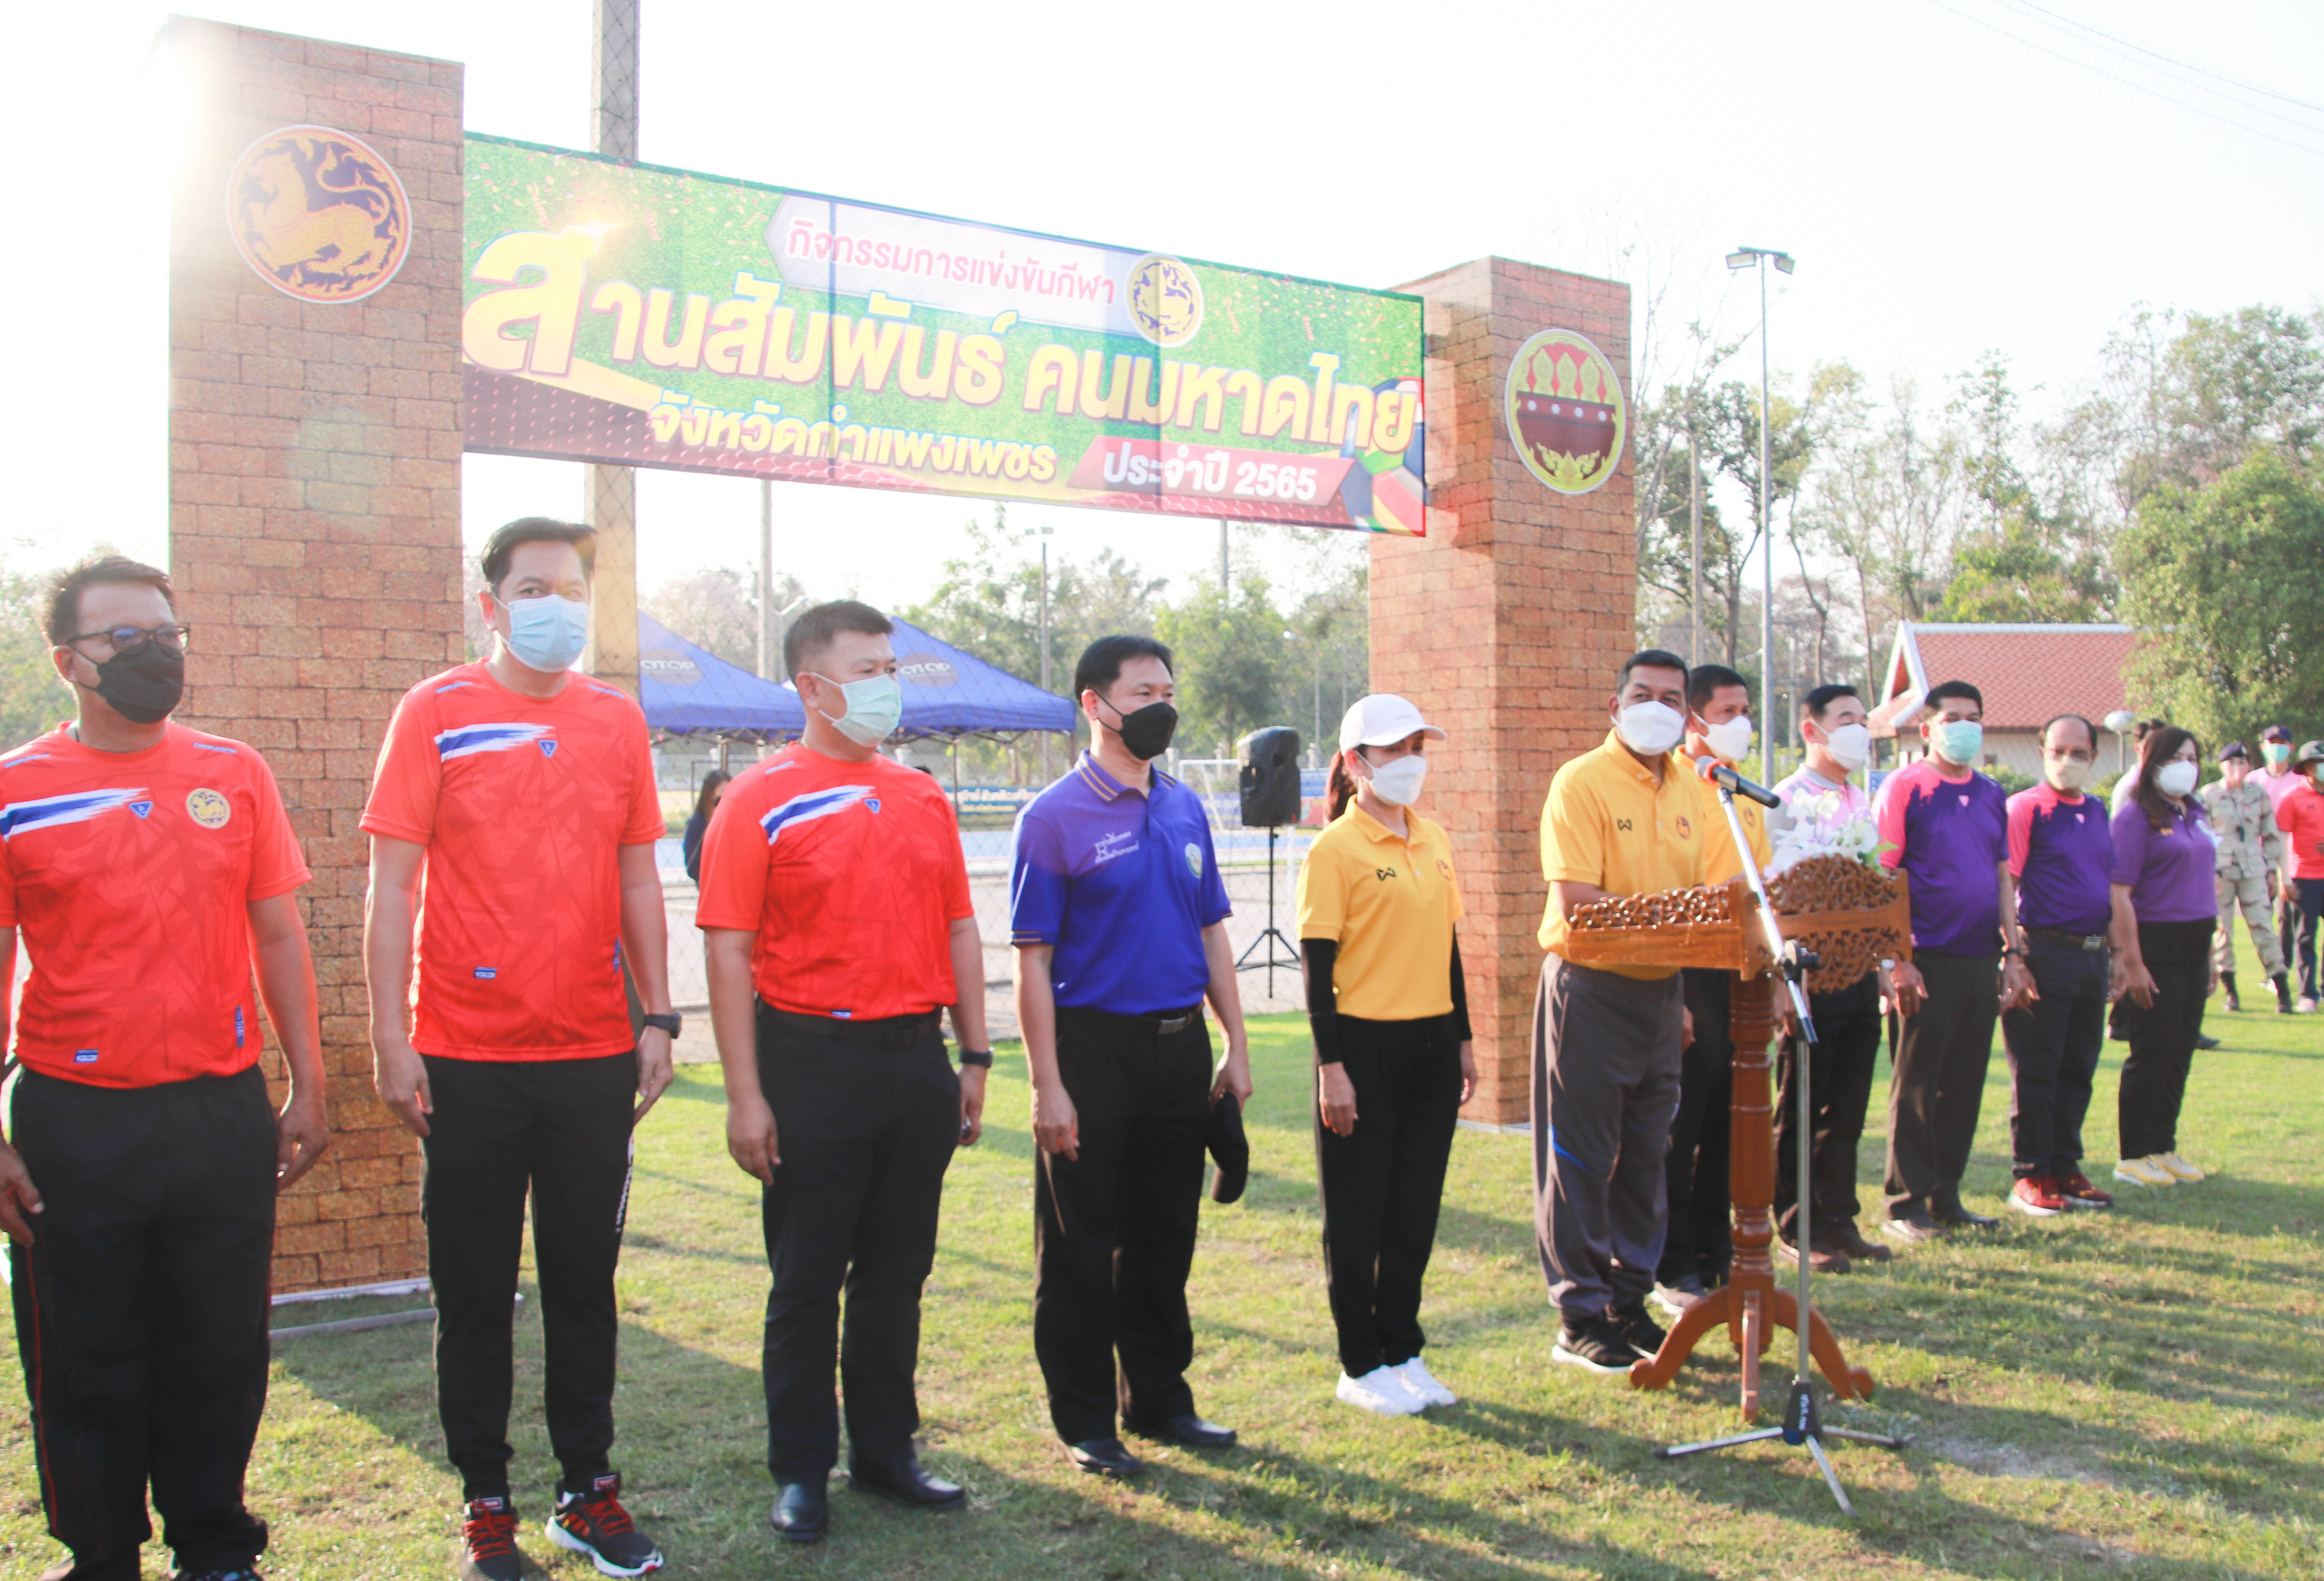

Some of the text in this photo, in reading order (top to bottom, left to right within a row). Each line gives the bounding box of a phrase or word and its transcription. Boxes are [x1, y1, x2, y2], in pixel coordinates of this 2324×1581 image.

[788, 219, 1114, 304] กิจกรรมการแข่งขันกีฬา
[462, 225, 1417, 453] สานสัมพันธ์ คนมหาดไทย
[650, 389, 1056, 481] จังหวัดกำแพงเพชร
[1103, 441, 1318, 501] ประจำปี 2565
